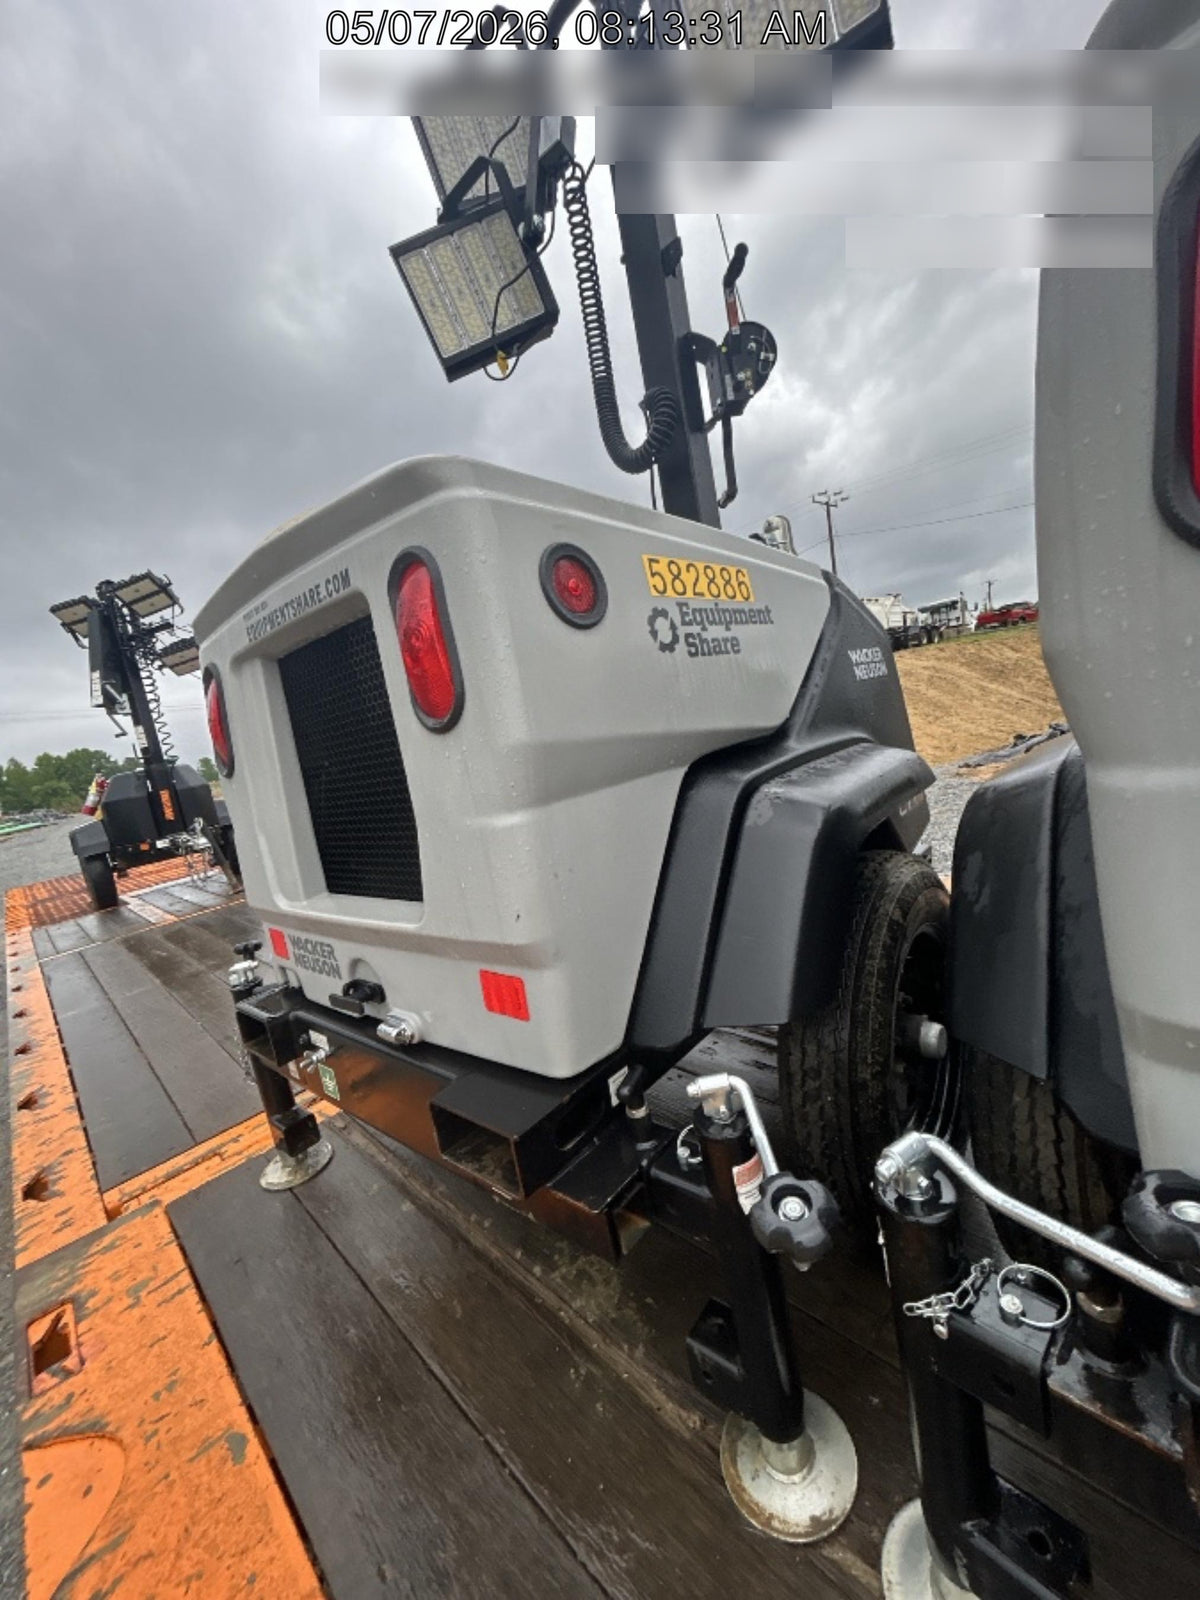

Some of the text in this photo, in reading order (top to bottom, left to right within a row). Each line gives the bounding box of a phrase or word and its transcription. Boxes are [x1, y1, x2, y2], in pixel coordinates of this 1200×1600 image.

[647, 557, 751, 601] 582886
[245, 567, 352, 643] EQUIPMENTSHARE.COM
[676, 602, 775, 629] Equipment
[684, 632, 741, 658] Share
[848, 648, 883, 663] WACKER
[854, 663, 888, 680] NEUSON
[287, 933, 338, 962] WACKER
[293, 953, 342, 979] NEUSON
